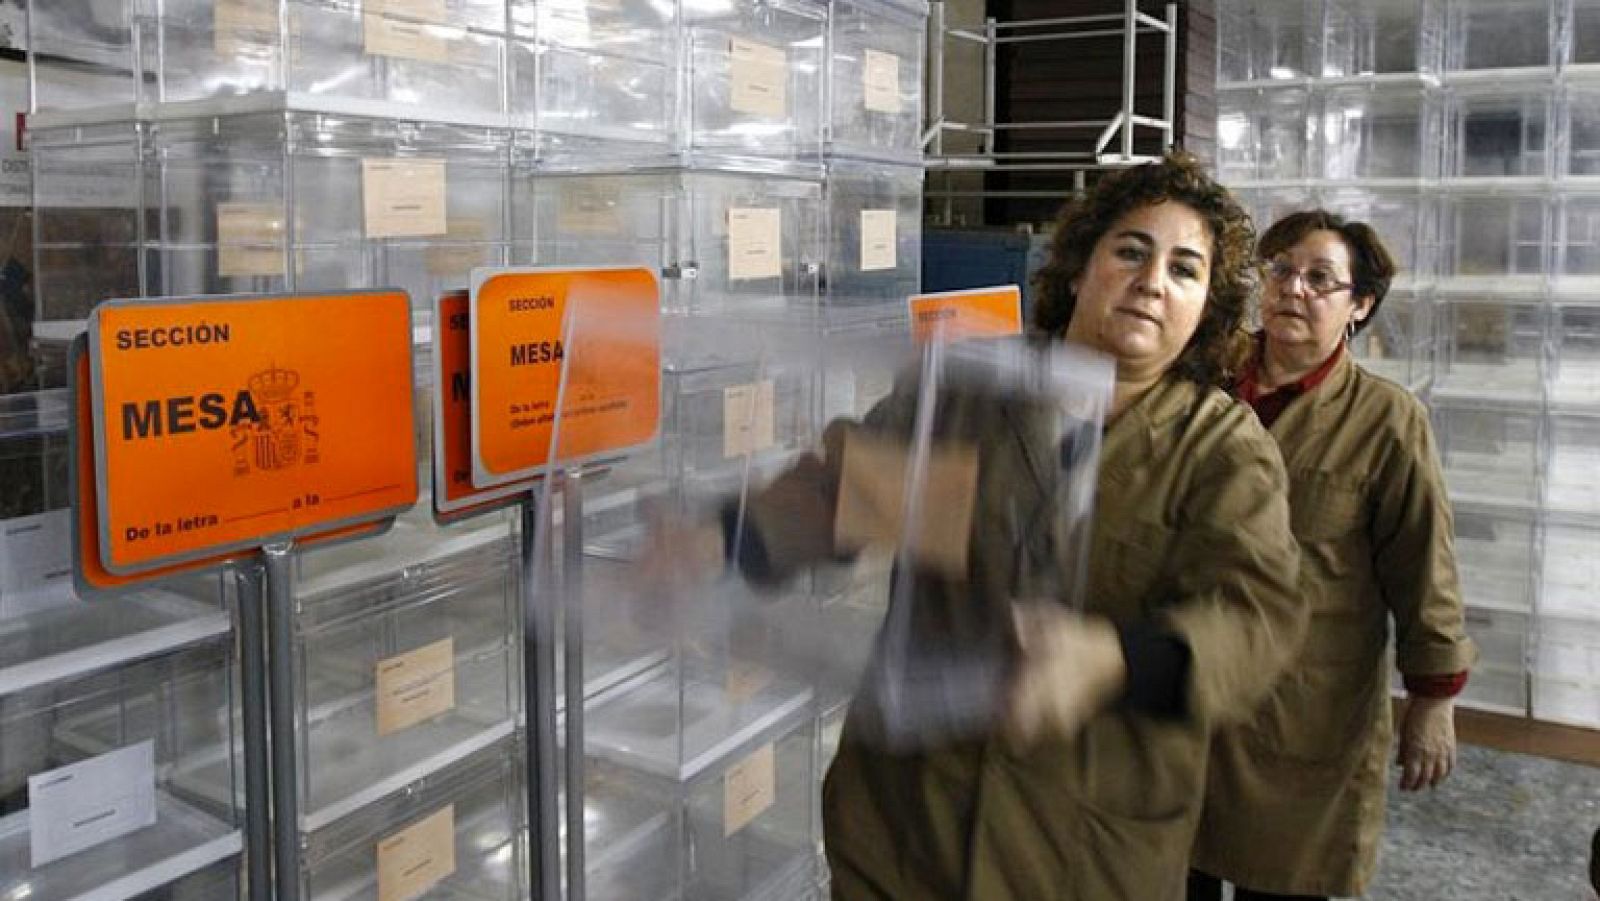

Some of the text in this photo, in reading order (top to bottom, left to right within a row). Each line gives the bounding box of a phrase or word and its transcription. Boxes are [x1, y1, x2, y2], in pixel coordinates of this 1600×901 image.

[509, 296, 555, 312] SECCIÓN
[116, 321, 230, 350] SECCIÓN
[510, 339, 564, 367] MESA
[121, 389, 262, 441] MESA
[126, 491, 321, 542] De la letra a la
